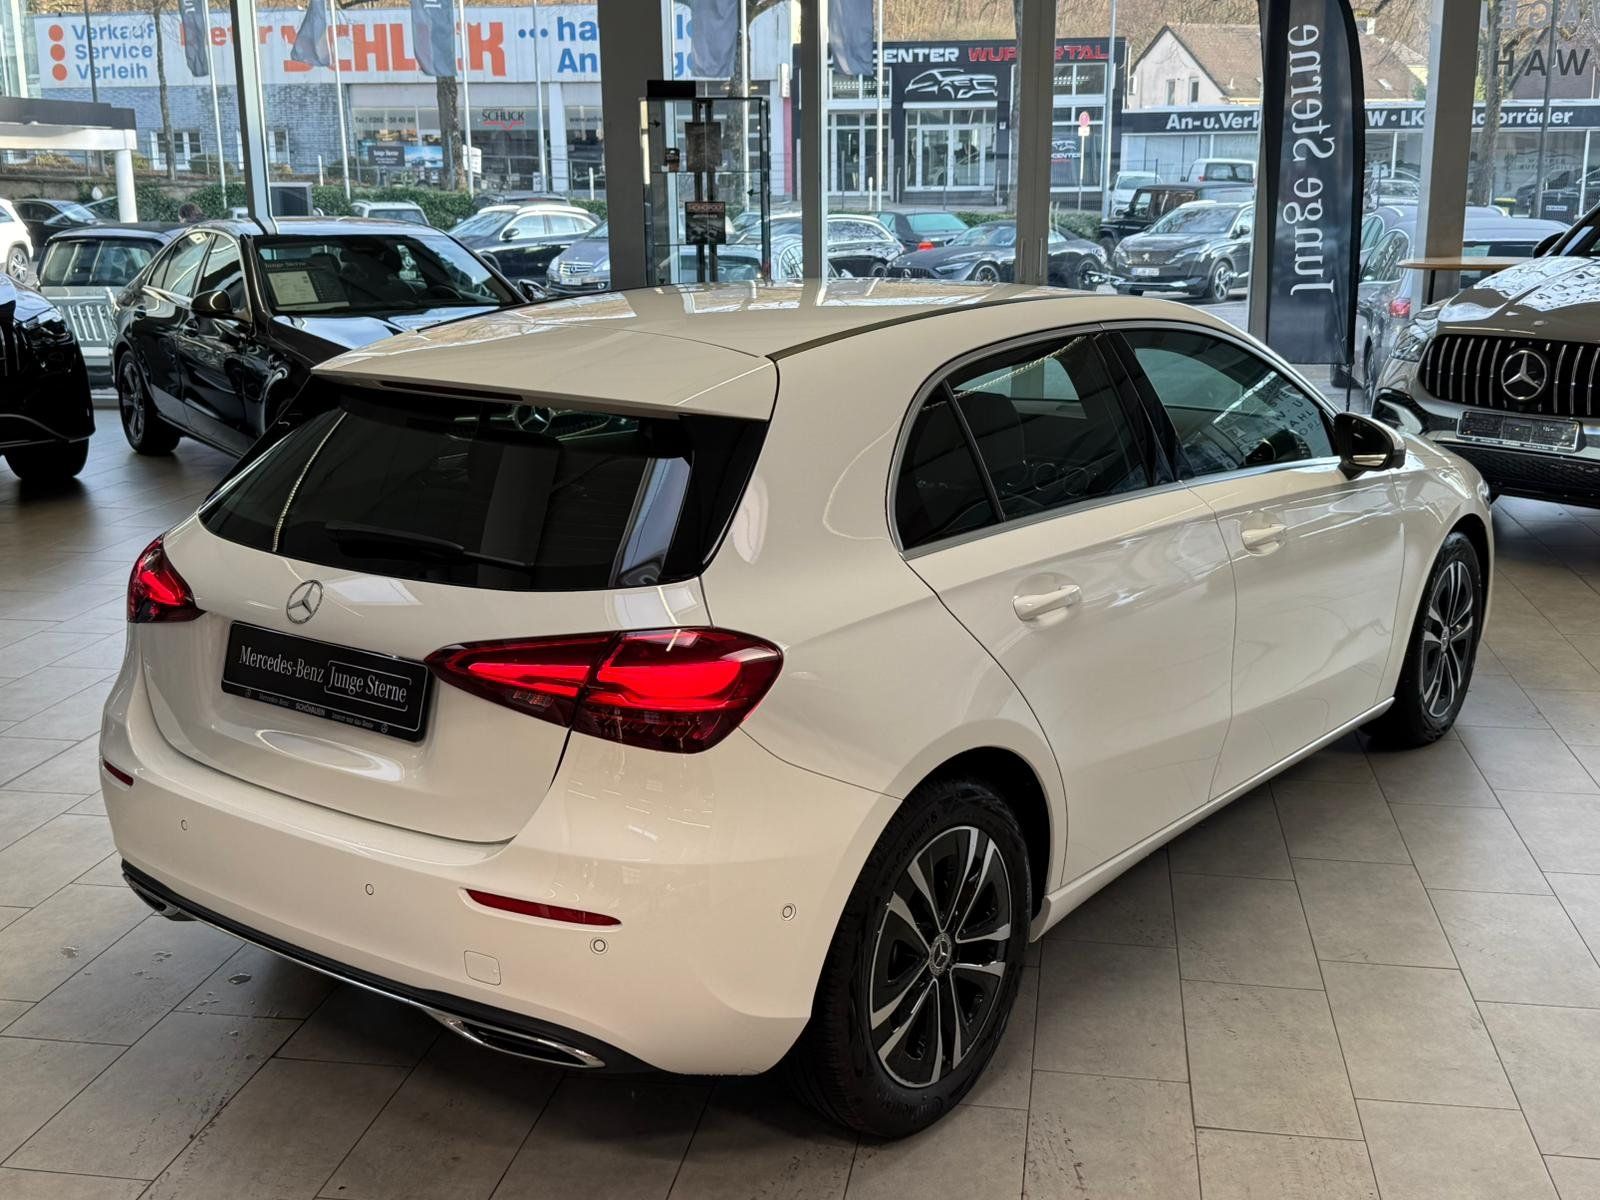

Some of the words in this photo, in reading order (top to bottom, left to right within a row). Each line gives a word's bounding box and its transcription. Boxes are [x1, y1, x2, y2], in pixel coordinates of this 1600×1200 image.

[71, 23, 155, 41] Verkauf
[75, 44, 153, 61] Service
[76, 63, 148, 81] Verleih
[239, 645, 325, 683] Mercedes-Benz
[327, 666, 364, 695] Junge
[366, 675, 407, 703] Sterne
